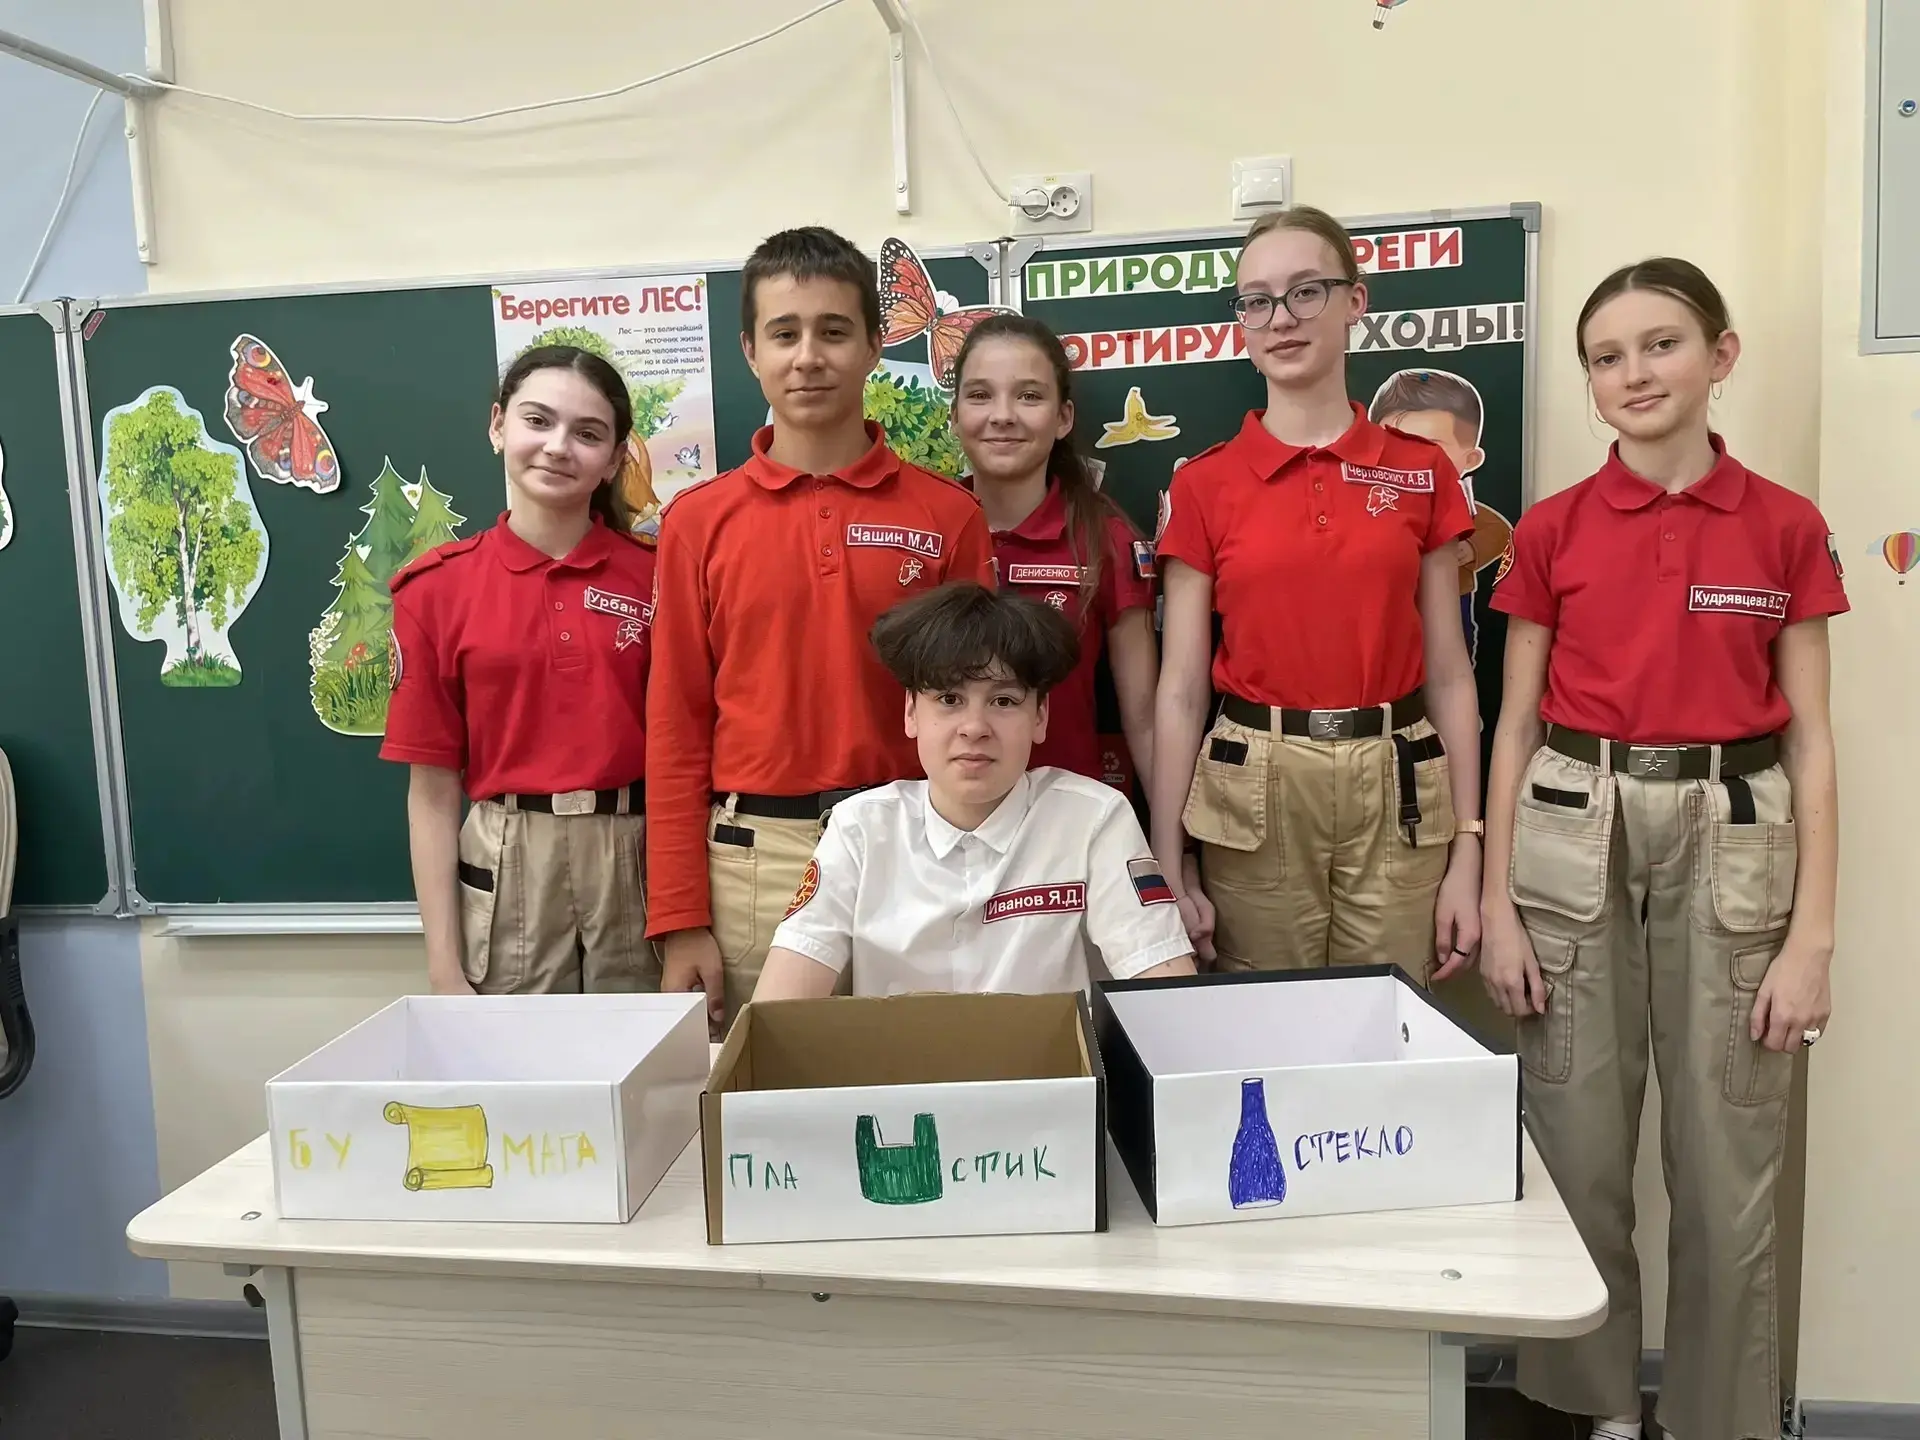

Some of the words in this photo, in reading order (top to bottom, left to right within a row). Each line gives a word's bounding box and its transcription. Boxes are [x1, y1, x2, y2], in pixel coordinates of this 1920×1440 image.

[1028, 251, 1237, 298] ПРИРОДУ
[1351, 230, 1459, 271] РЕГИ
[501, 295, 630, 325] Берегите
[639, 285, 701, 313] ЛЕС!
[618, 327, 632, 335] Лес
[657, 324, 703, 333] величайший
[1061, 323, 1248, 369] ОРТИРУ
[1359, 305, 1523, 350] ХОДЫ!
[627, 369, 669, 377] прекрасной
[1348, 463, 1406, 485] Чертовских
[1407, 473, 1429, 486] А.В.
[851, 527, 904, 543] Чашин
[907, 531, 938, 554] М.А.
[1016, 568, 1070, 578] ДЕНИСЕНКО
[590, 591, 638, 615] Урбан
[1694, 590, 1767, 607] Кудрявцева
[1768, 595, 1784, 610] В.С.
[988, 895, 1044, 915] Иванов
[1048, 889, 1081, 907] Я.Д.
[503, 1131, 598, 1177] МАГА
[1294, 1125, 1413, 1171] СТЕКЛО
[728, 1153, 798, 1191] ПЛА
[952, 1145, 1056, 1183] СТИК
